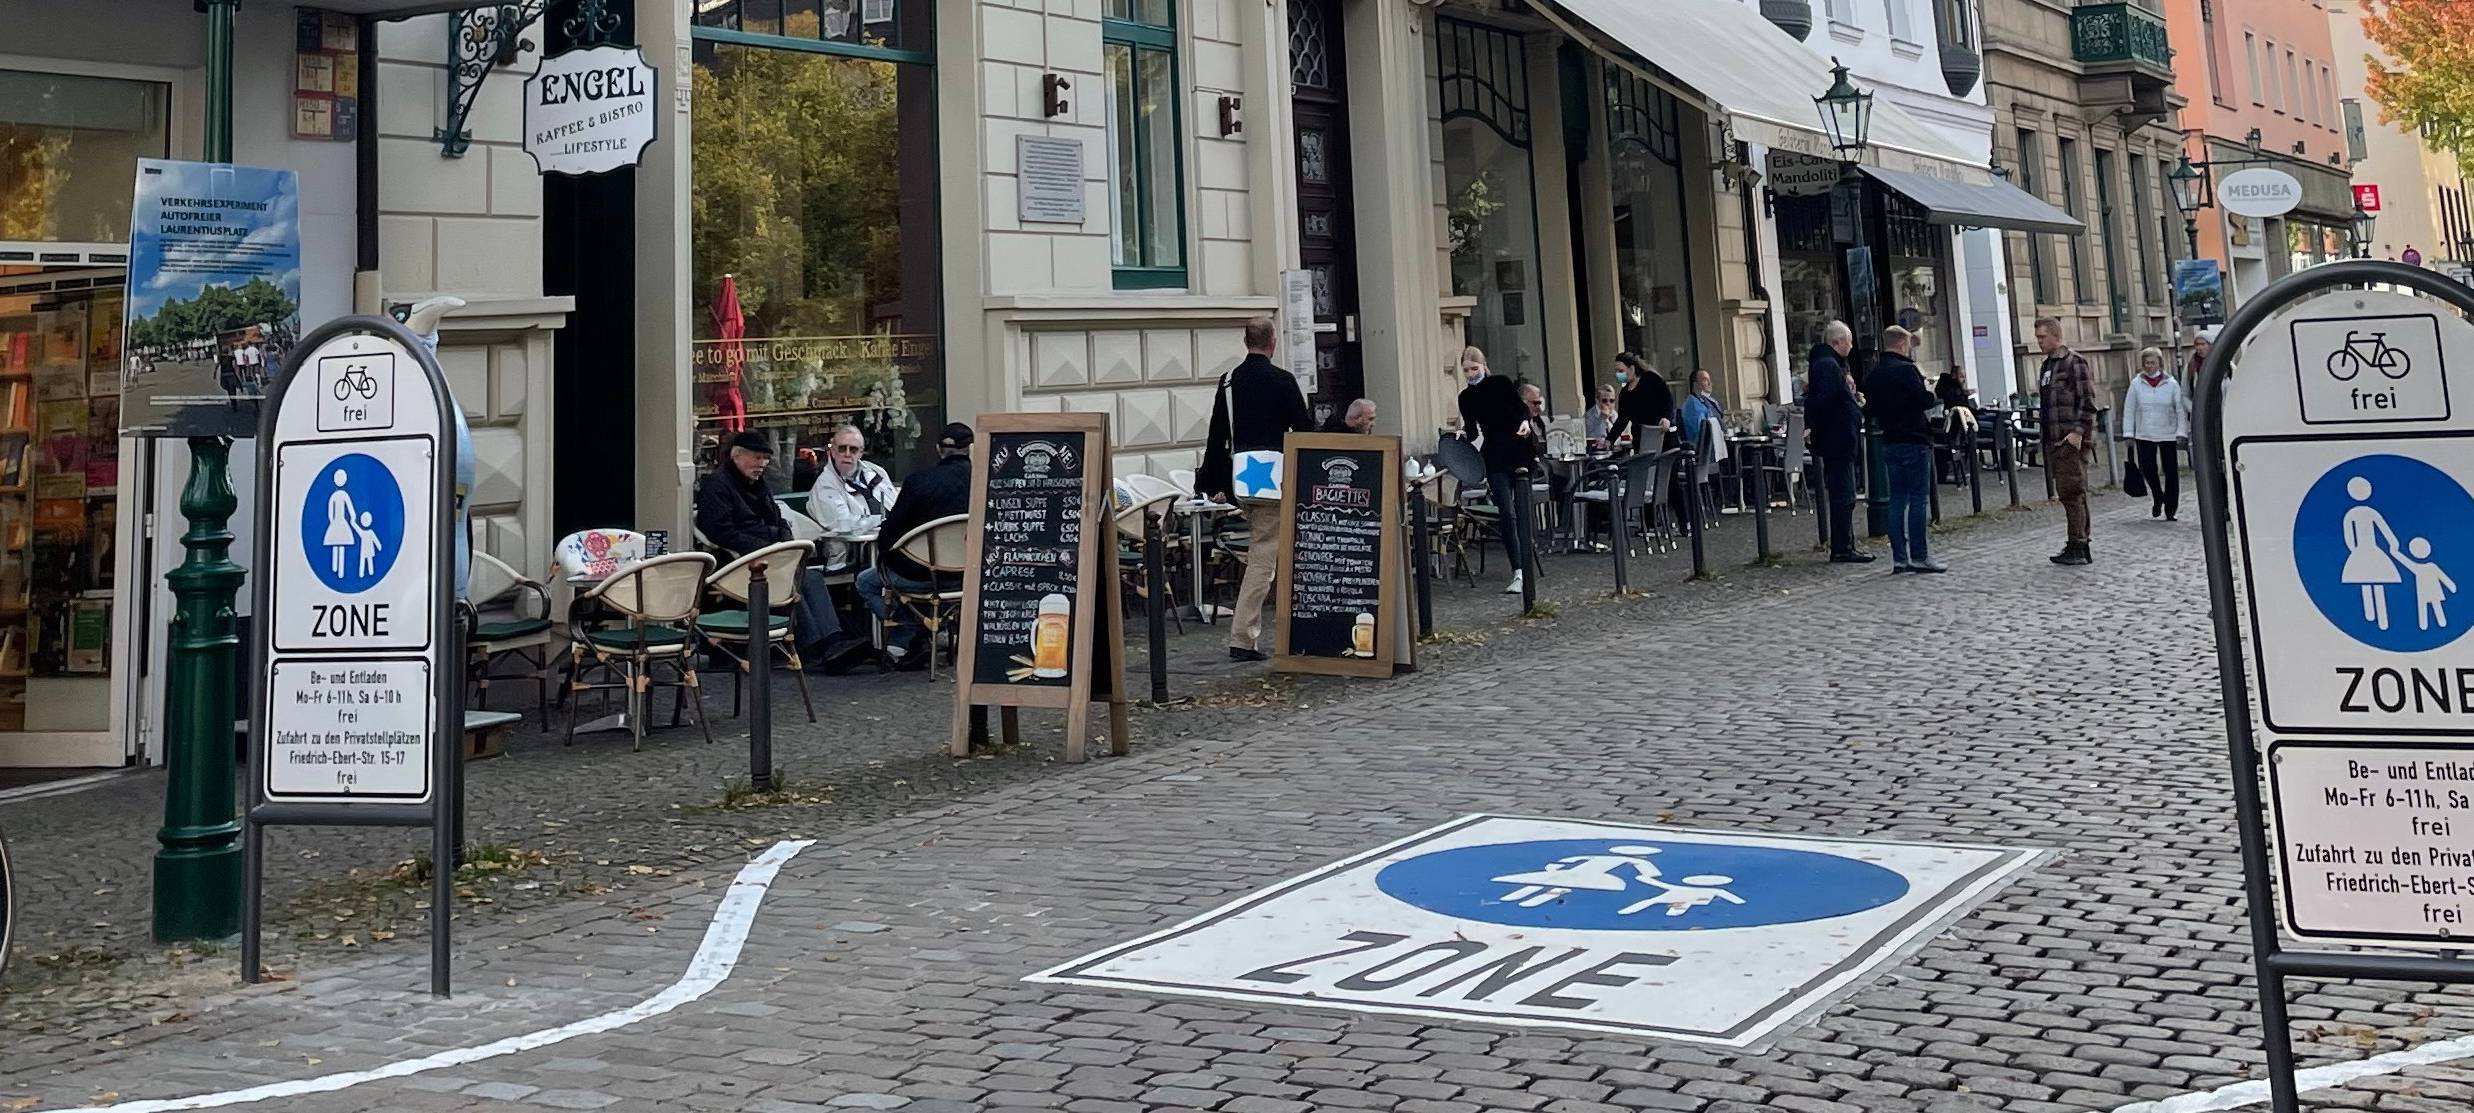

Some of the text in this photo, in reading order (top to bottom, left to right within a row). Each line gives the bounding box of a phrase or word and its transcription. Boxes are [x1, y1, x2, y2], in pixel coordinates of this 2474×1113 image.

[540, 65, 645, 106] ENGEL
[536, 101, 643, 145] KAFFEE & BISTRO
[564, 138, 627, 155] LIFESTYLE
[1772, 168, 1838, 184] Mandoliti
[2228, 184, 2291, 198] MEDUSA
[160, 212, 222, 222] AUTOFREIER
[708, 345, 723, 365] to
[773, 341, 848, 362] Geschmack
[2351, 386, 2396, 410] frei
[343, 405, 367, 421] frei
[1022, 522, 1046, 532] SUPPE
[1004, 533, 1029, 542] LACHS
[992, 566, 1036, 578] CAPRESE
[312, 604, 389, 637] ZONE
[311, 670, 387, 684] Be- und Entladen
[296, 690, 323, 704] Mo-Fr
[359, 690, 370, 704] Sa
[338, 709, 358, 723] frei
[276, 730, 421, 748] Zufahrt zu den Privatstellplätzen
[289, 751, 405, 765] Friedrich-Ebert-Str. 15-17
[337, 770, 357, 785] frei
[2348, 759, 2379, 779] Be-
[2387, 761, 2418, 780] und
[2324, 787, 2376, 807] Mo-Fr
[2448, 790, 2470, 809] Sa
[2412, 817, 2450, 836] frei
[2295, 843, 2356, 864] Zufahrt
[2365, 850, 2384, 865] zu
[2391, 846, 2421, 866] den
[2423, 903, 2462, 923] frei
[1234, 931, 1681, 1010] ZONE
